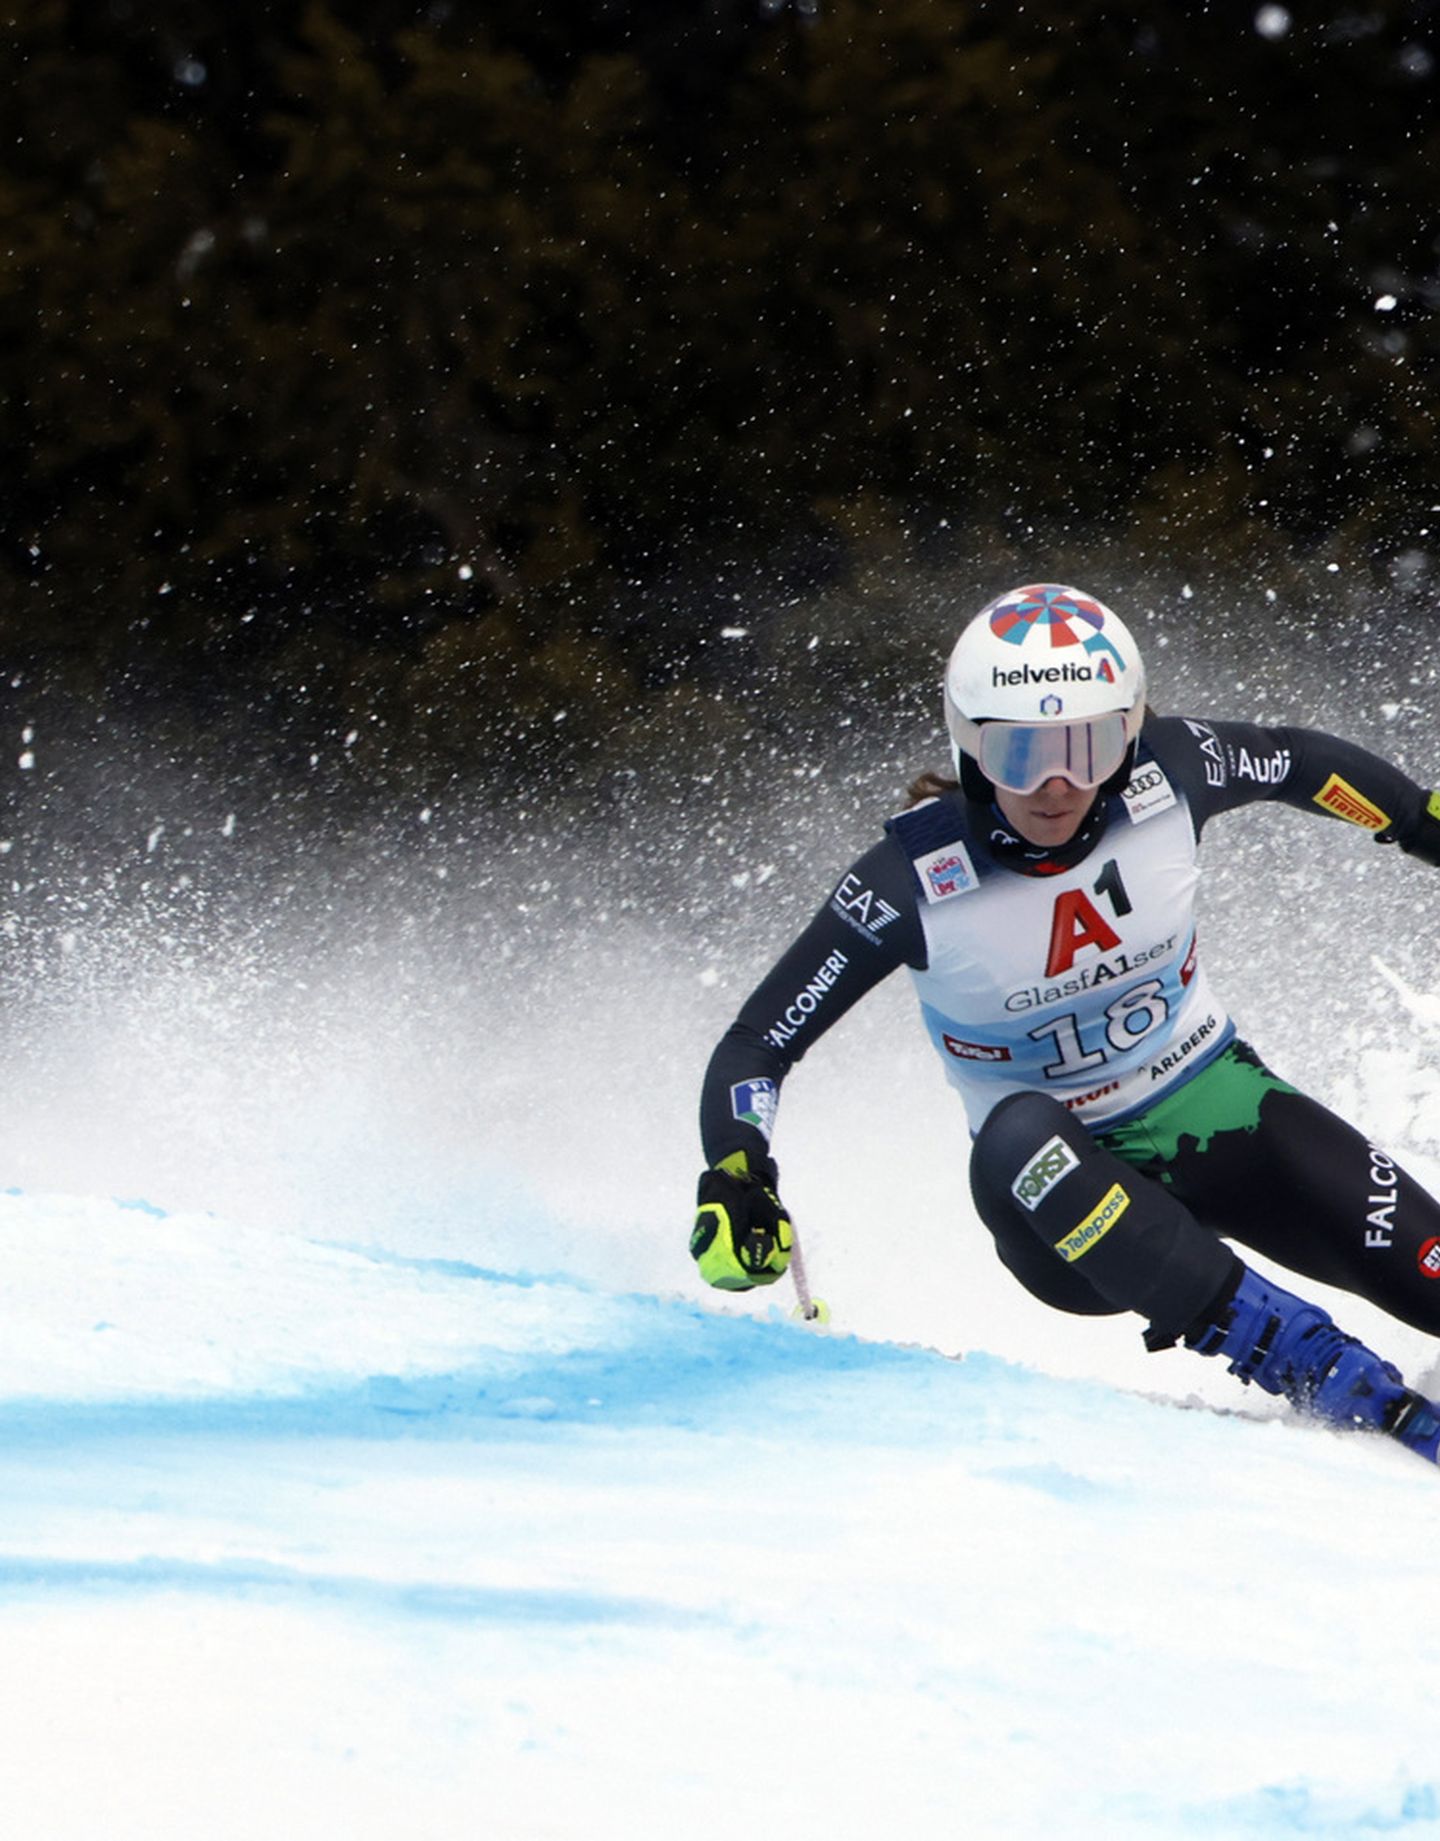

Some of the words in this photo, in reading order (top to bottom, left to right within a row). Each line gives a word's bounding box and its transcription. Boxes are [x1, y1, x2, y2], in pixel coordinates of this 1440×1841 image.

[992, 663, 1092, 688] helvetia
[1238, 747, 1291, 784] Audi
[1322, 784, 1383, 829] PIRELLI
[834, 872, 901, 932] EA7
[1044, 858, 1134, 979] A1
[1004, 934, 1178, 1014] GlasfA1ser
[1027, 978, 1170, 1080] 18
[1150, 1015, 1217, 1080] ARLBERG
[1016, 1142, 1072, 1206] FORST
[1065, 1191, 1124, 1252] Telepass
